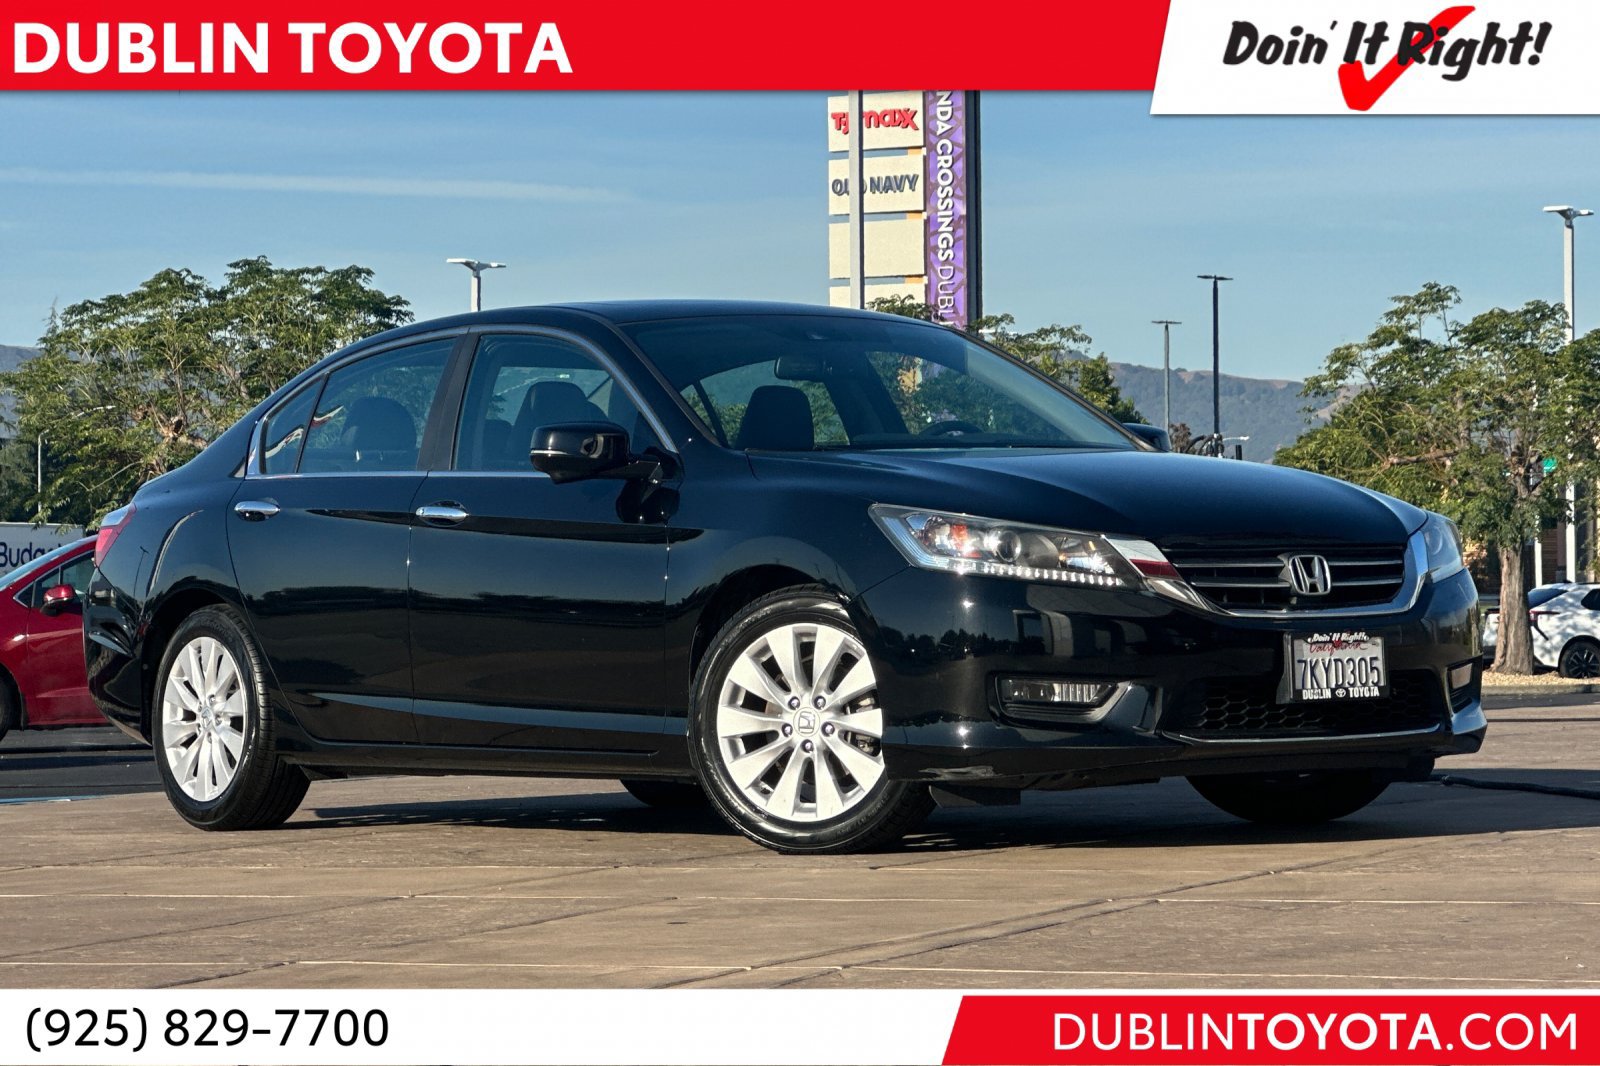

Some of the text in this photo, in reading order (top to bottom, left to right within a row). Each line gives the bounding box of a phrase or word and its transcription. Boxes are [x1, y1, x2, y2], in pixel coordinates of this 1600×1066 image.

[832, 174, 919, 196] OL NAVY
[936, 91, 956, 325] NDA CROSSINGS DUBLI
[1297, 656, 1381, 690] 7KYD305
[1302, 686, 1380, 700] DUBLIN TOYOTA
